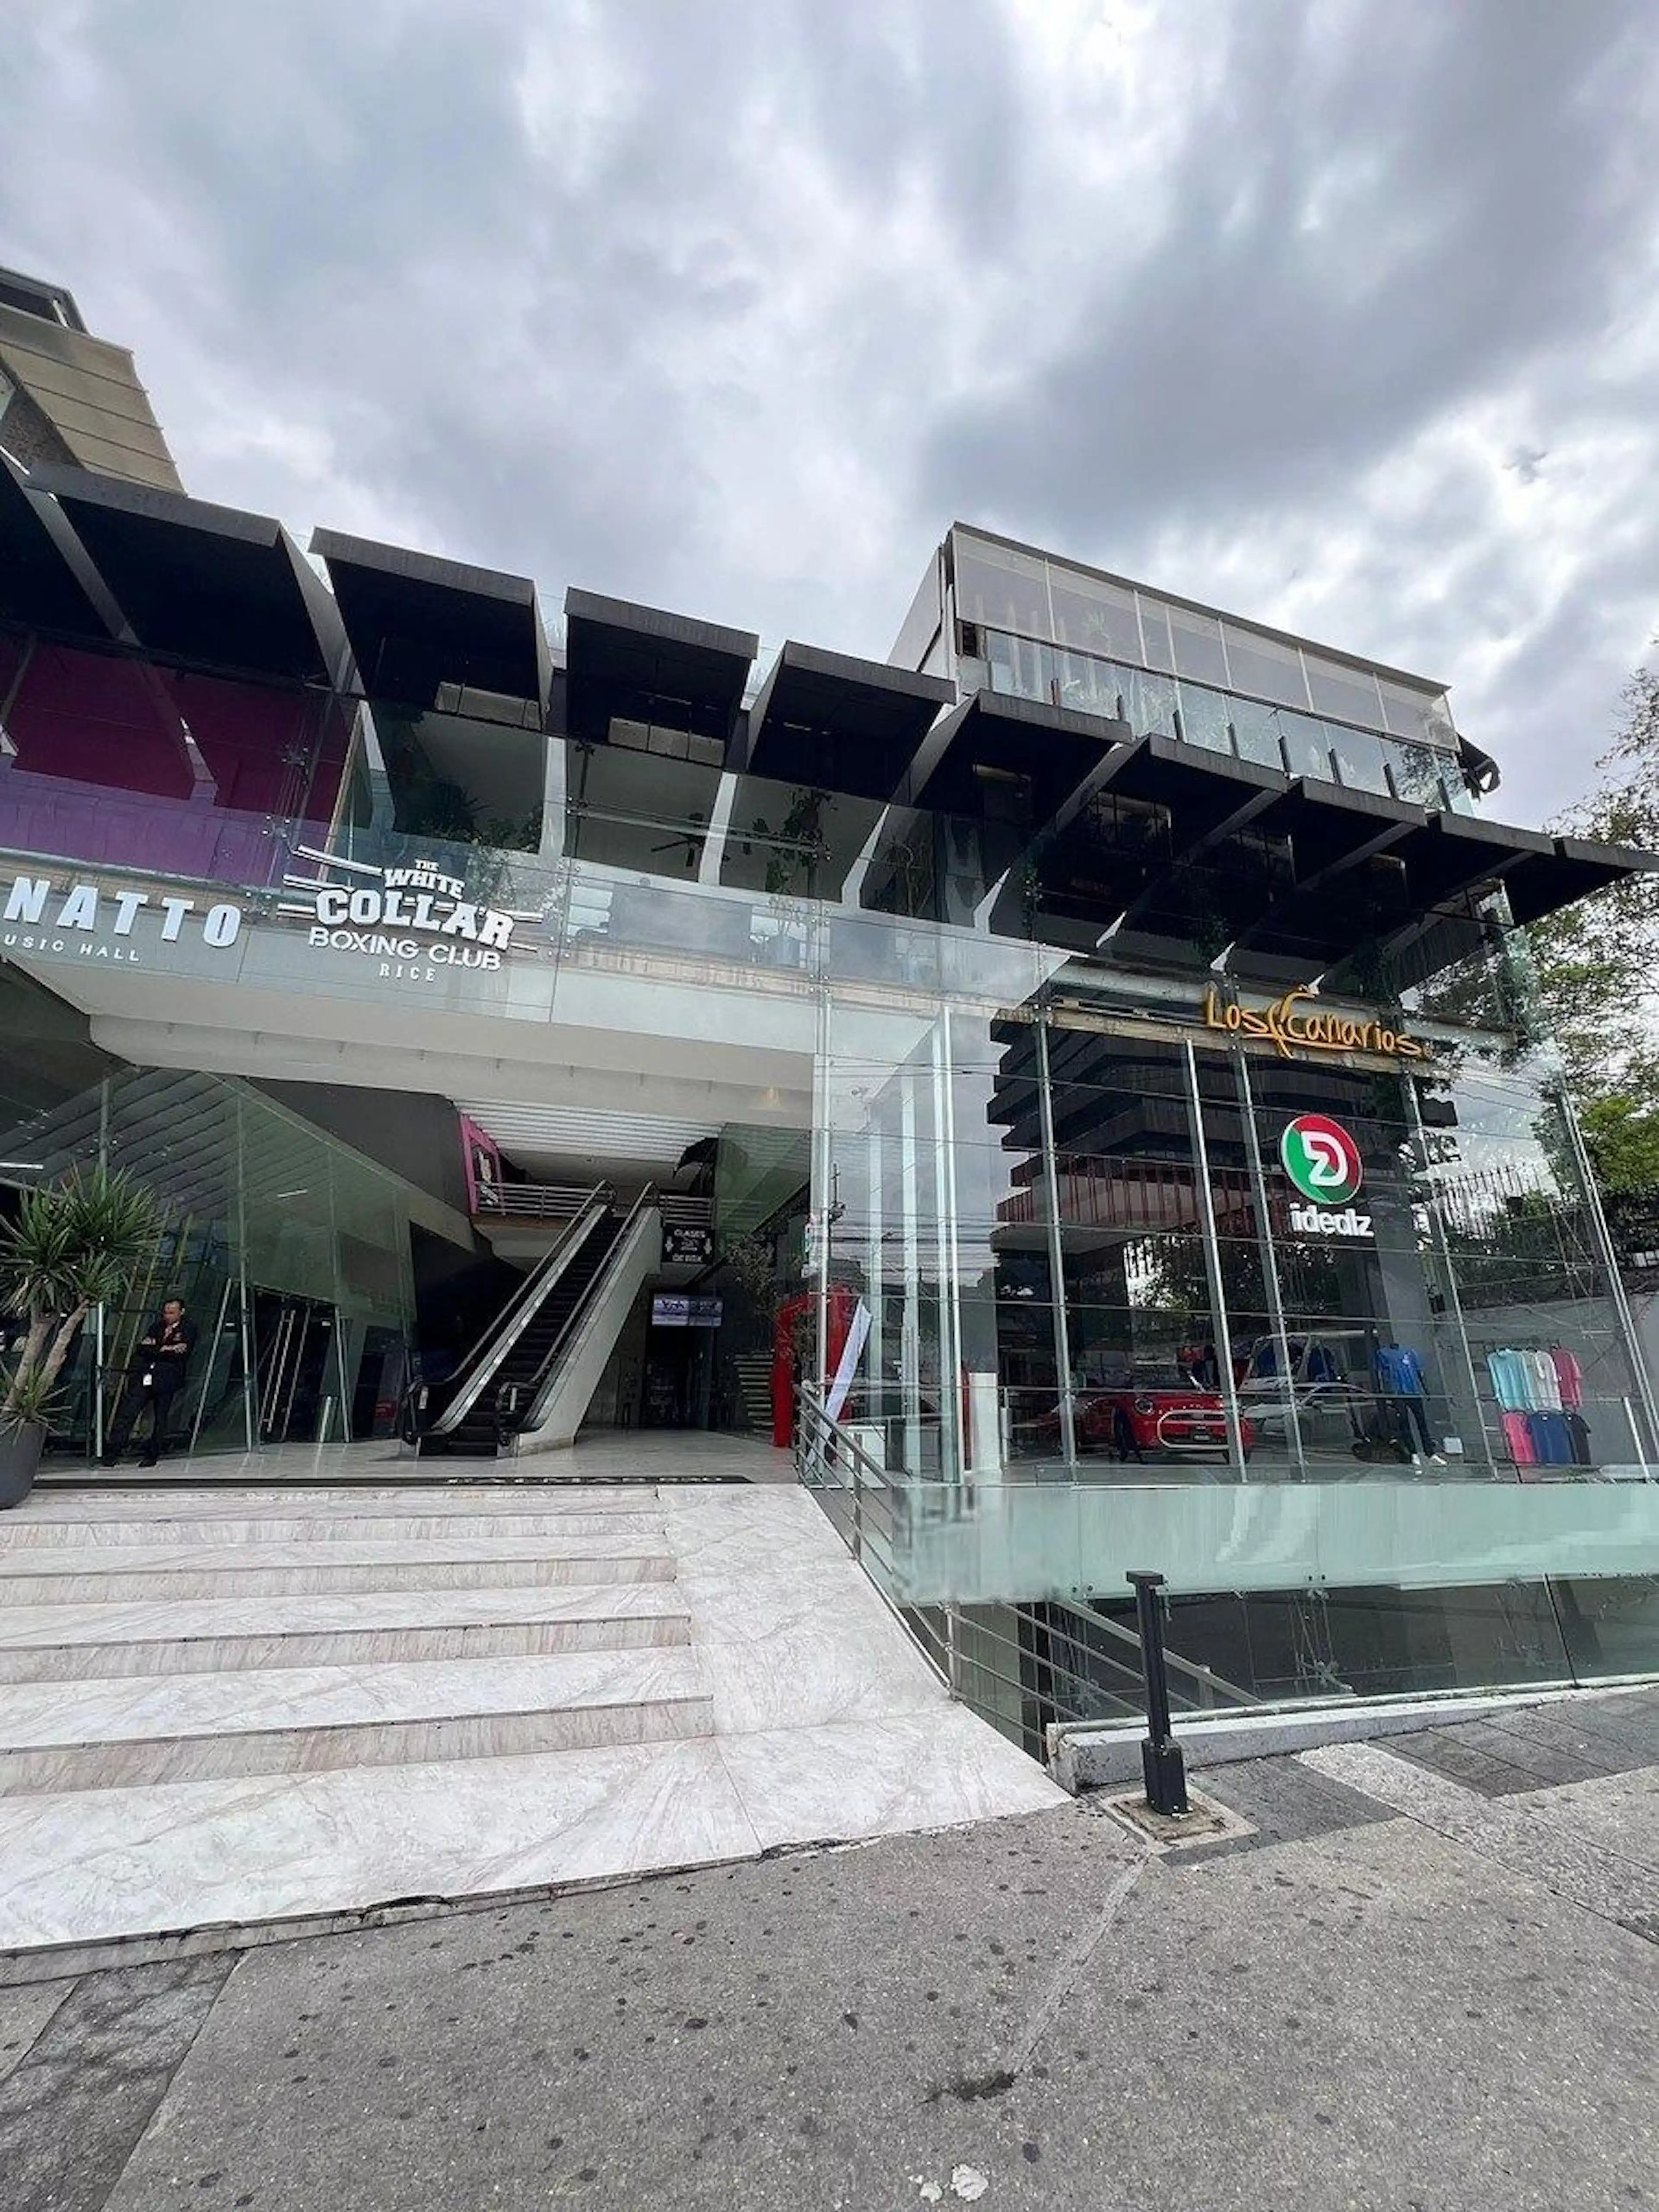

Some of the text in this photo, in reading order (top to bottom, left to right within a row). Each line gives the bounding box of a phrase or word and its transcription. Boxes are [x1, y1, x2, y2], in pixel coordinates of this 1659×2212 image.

[414, 858, 439, 872] THE
[384, 868, 466, 900] WHITE
[3, 876, 243, 947] NATTO
[316, 889, 515, 950] COLLAR
[79, 943, 140, 962] HALL
[308, 926, 502, 971] BOXING CLUB
[379, 963, 437, 982] RICE
[1207, 985, 1422, 1058] Los Canarios
[1289, 1202, 1375, 1237] idealz
